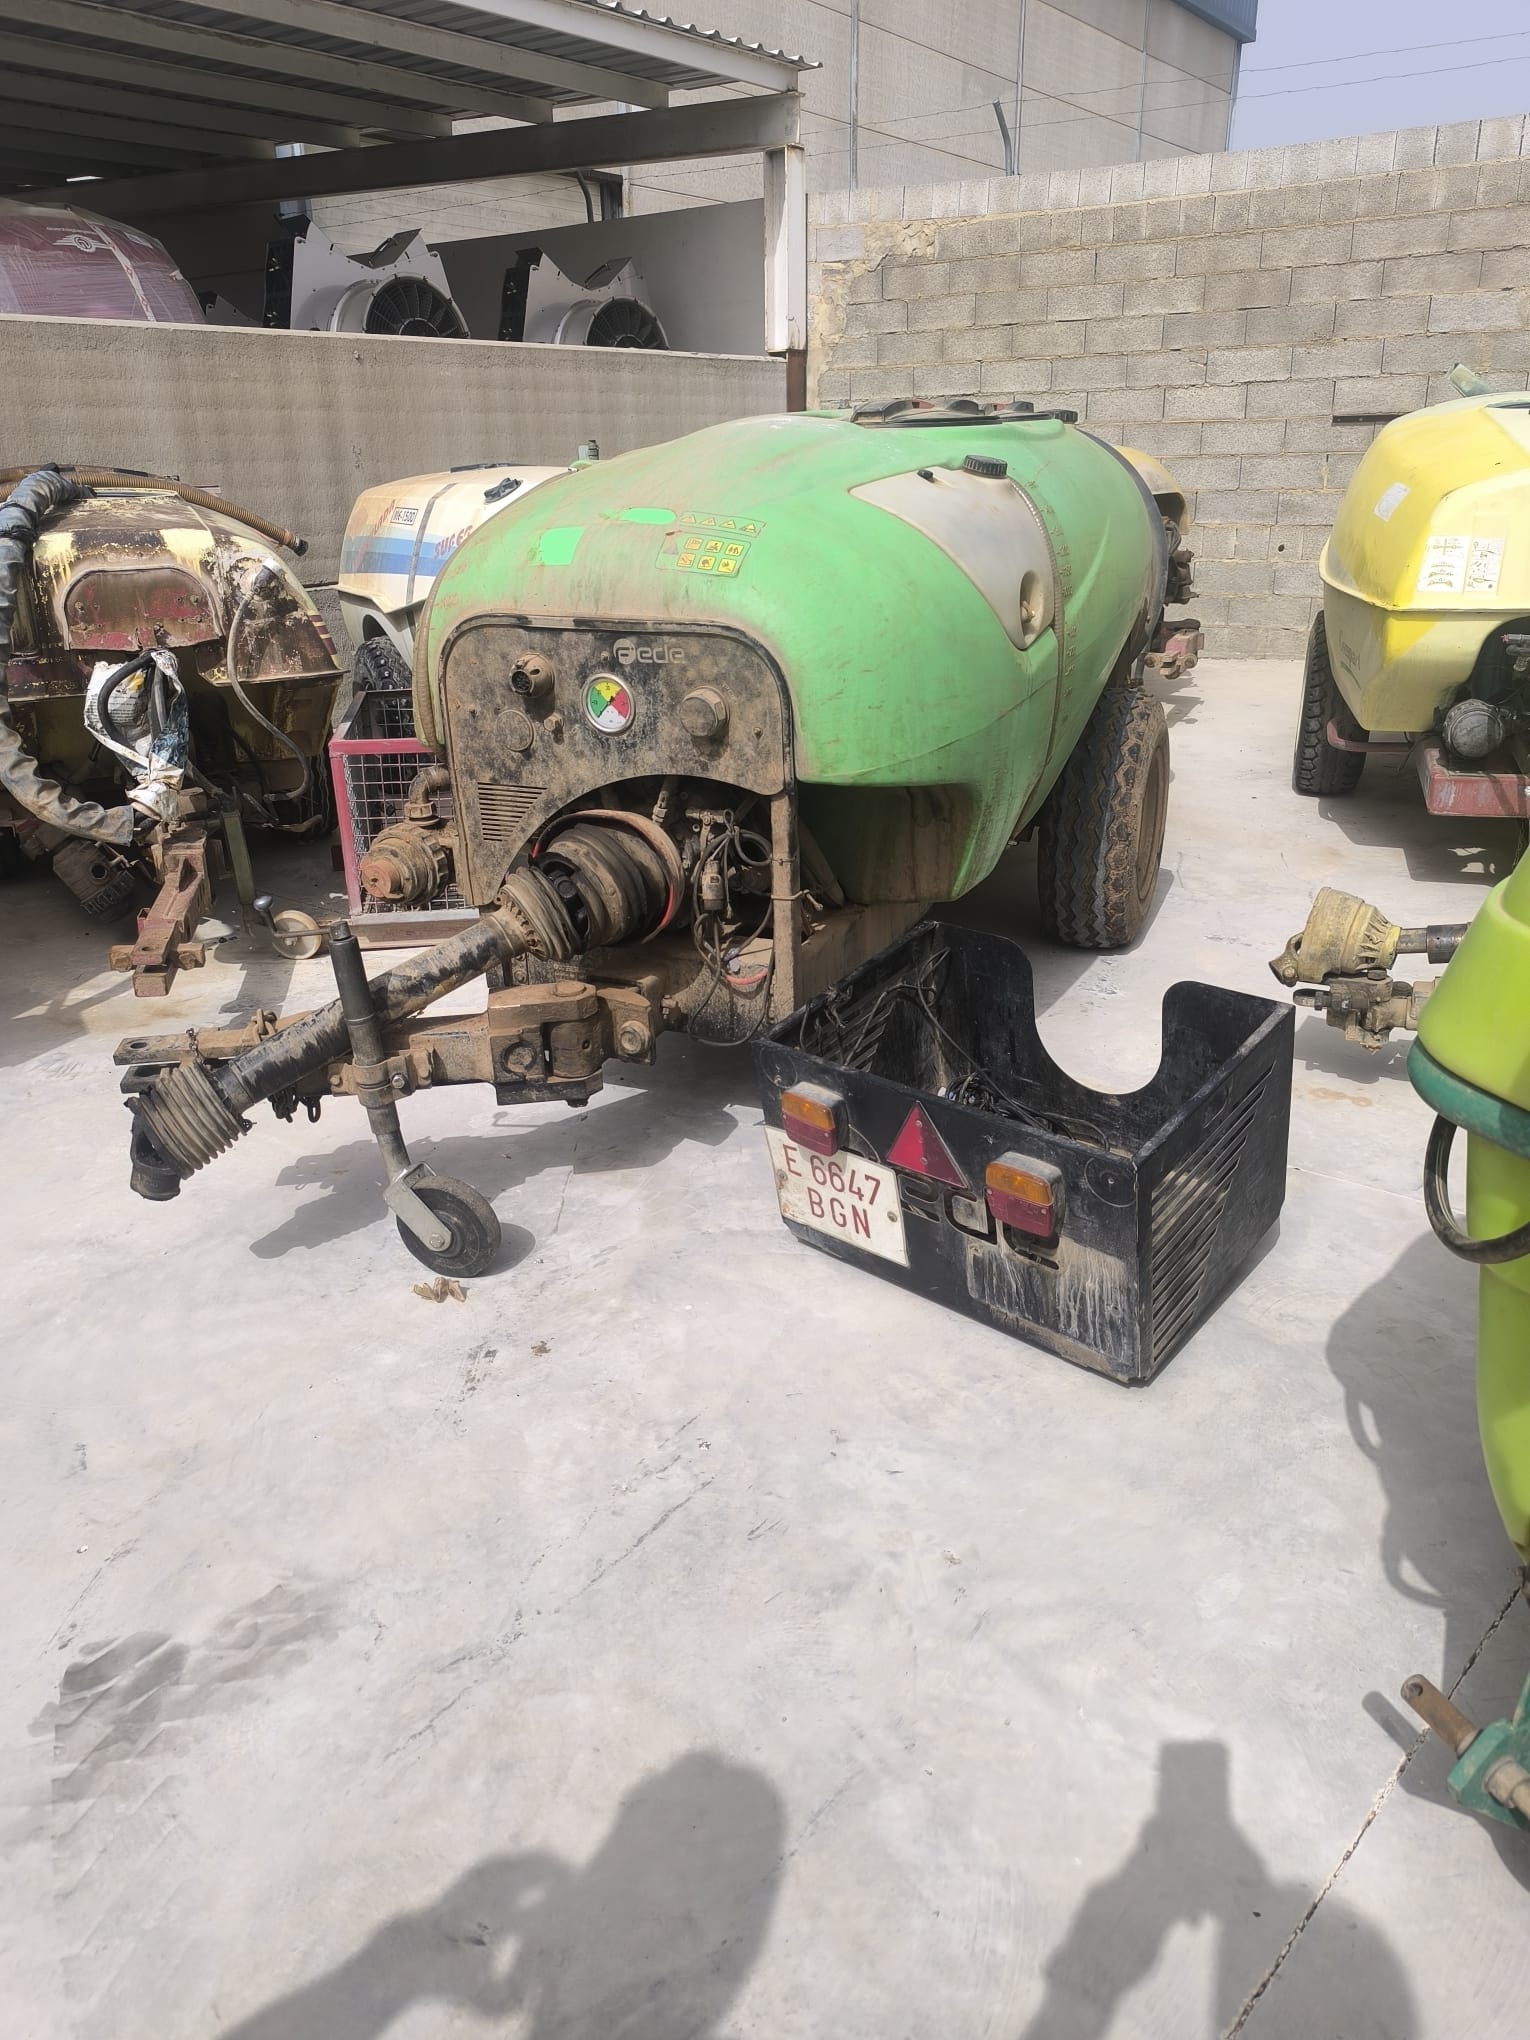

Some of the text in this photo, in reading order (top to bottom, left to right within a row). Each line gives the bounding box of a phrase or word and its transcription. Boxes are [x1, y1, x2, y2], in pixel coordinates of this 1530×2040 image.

[613, 638, 685, 665] Fede
[782, 1143, 881, 1206] E 6647
[806, 1186, 871, 1240] BGN
